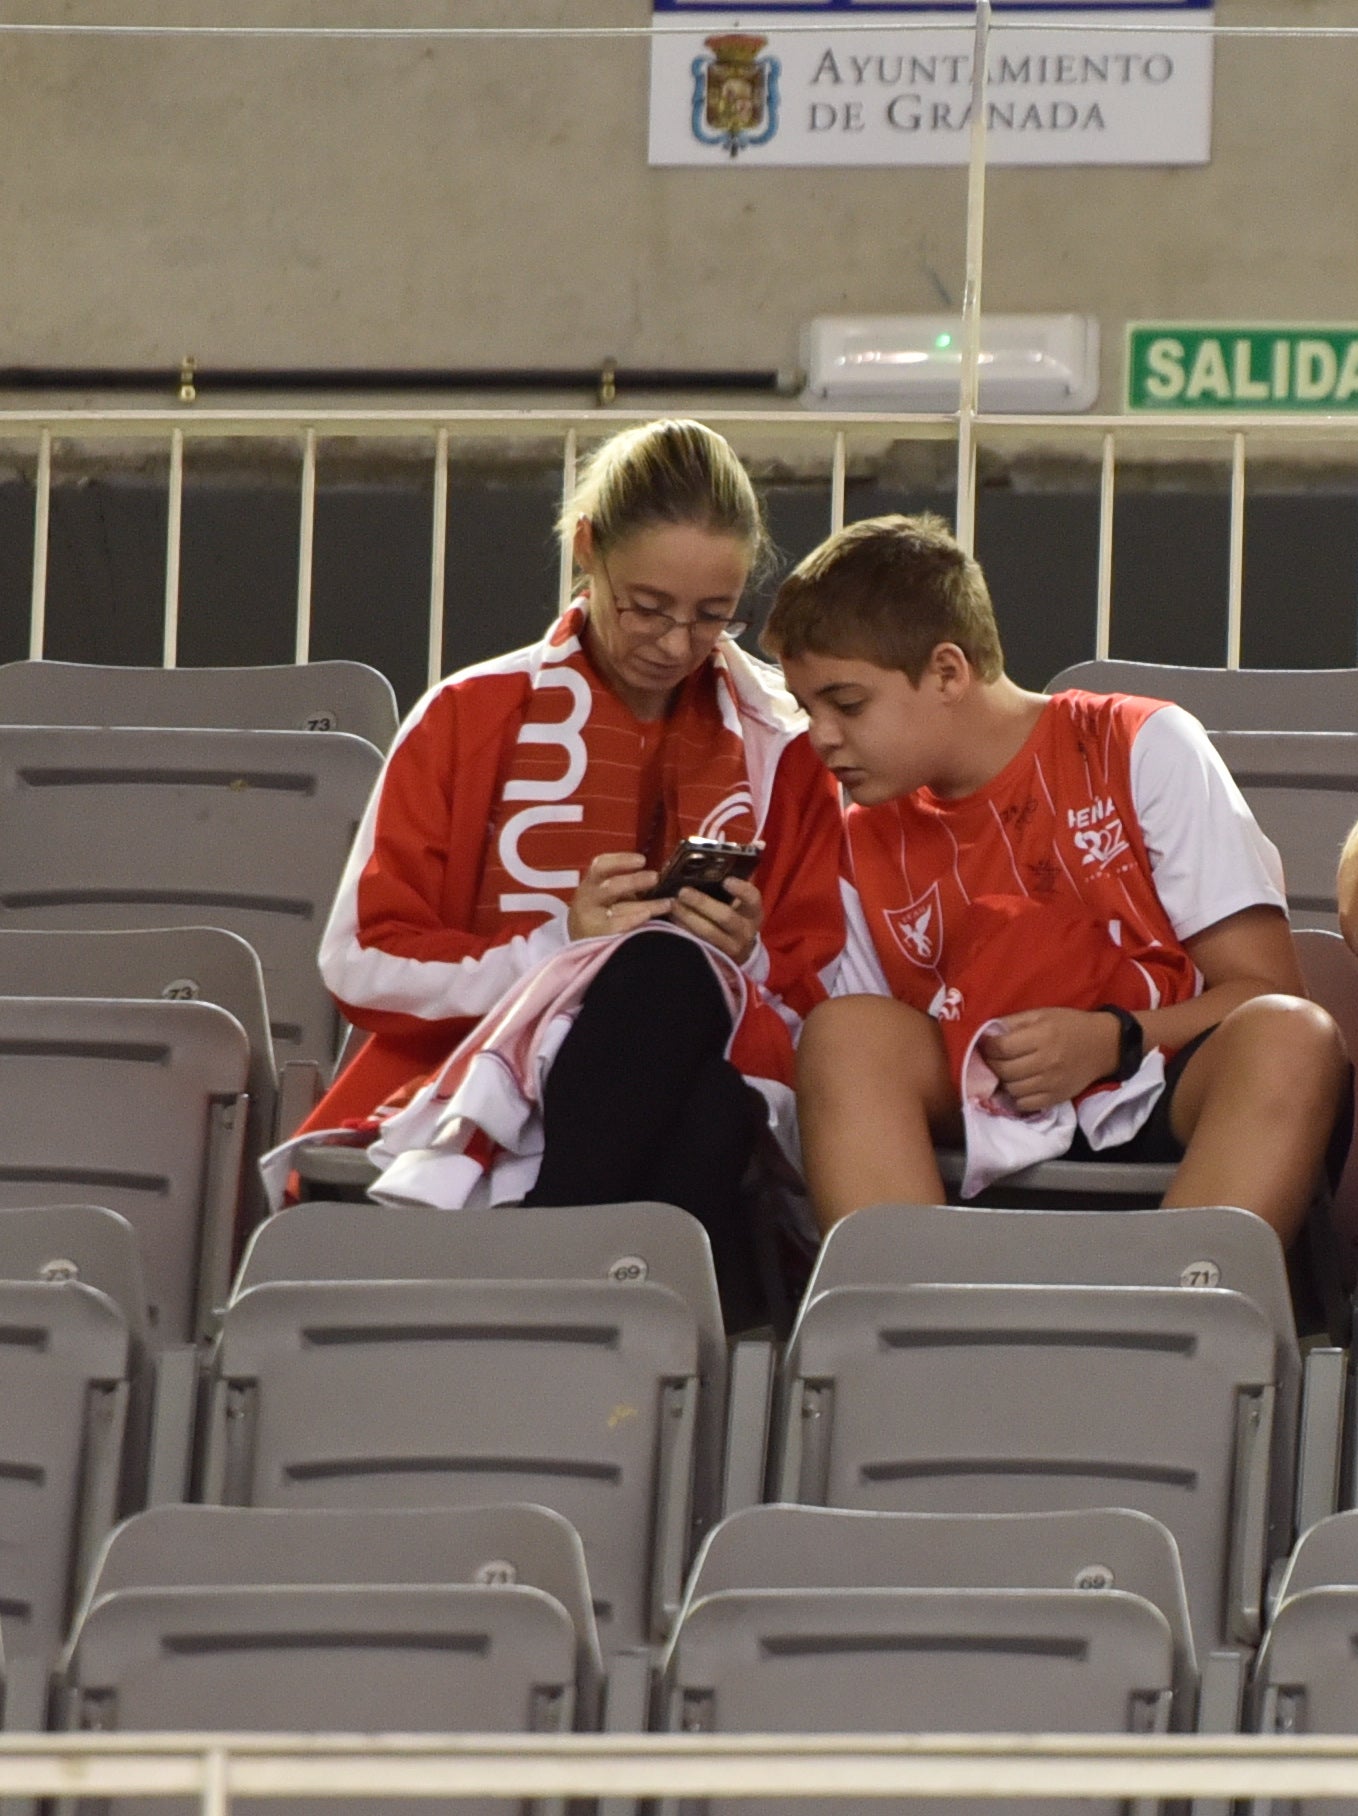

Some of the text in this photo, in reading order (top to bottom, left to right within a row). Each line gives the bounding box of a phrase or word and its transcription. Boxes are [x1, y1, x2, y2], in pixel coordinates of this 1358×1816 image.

[807, 101, 866, 132] DE
[307, 718, 331, 732] 73
[169, 986, 193, 1000] 73
[614, 1265, 640, 1281] 69
[1189, 1270, 1210, 1286] 71
